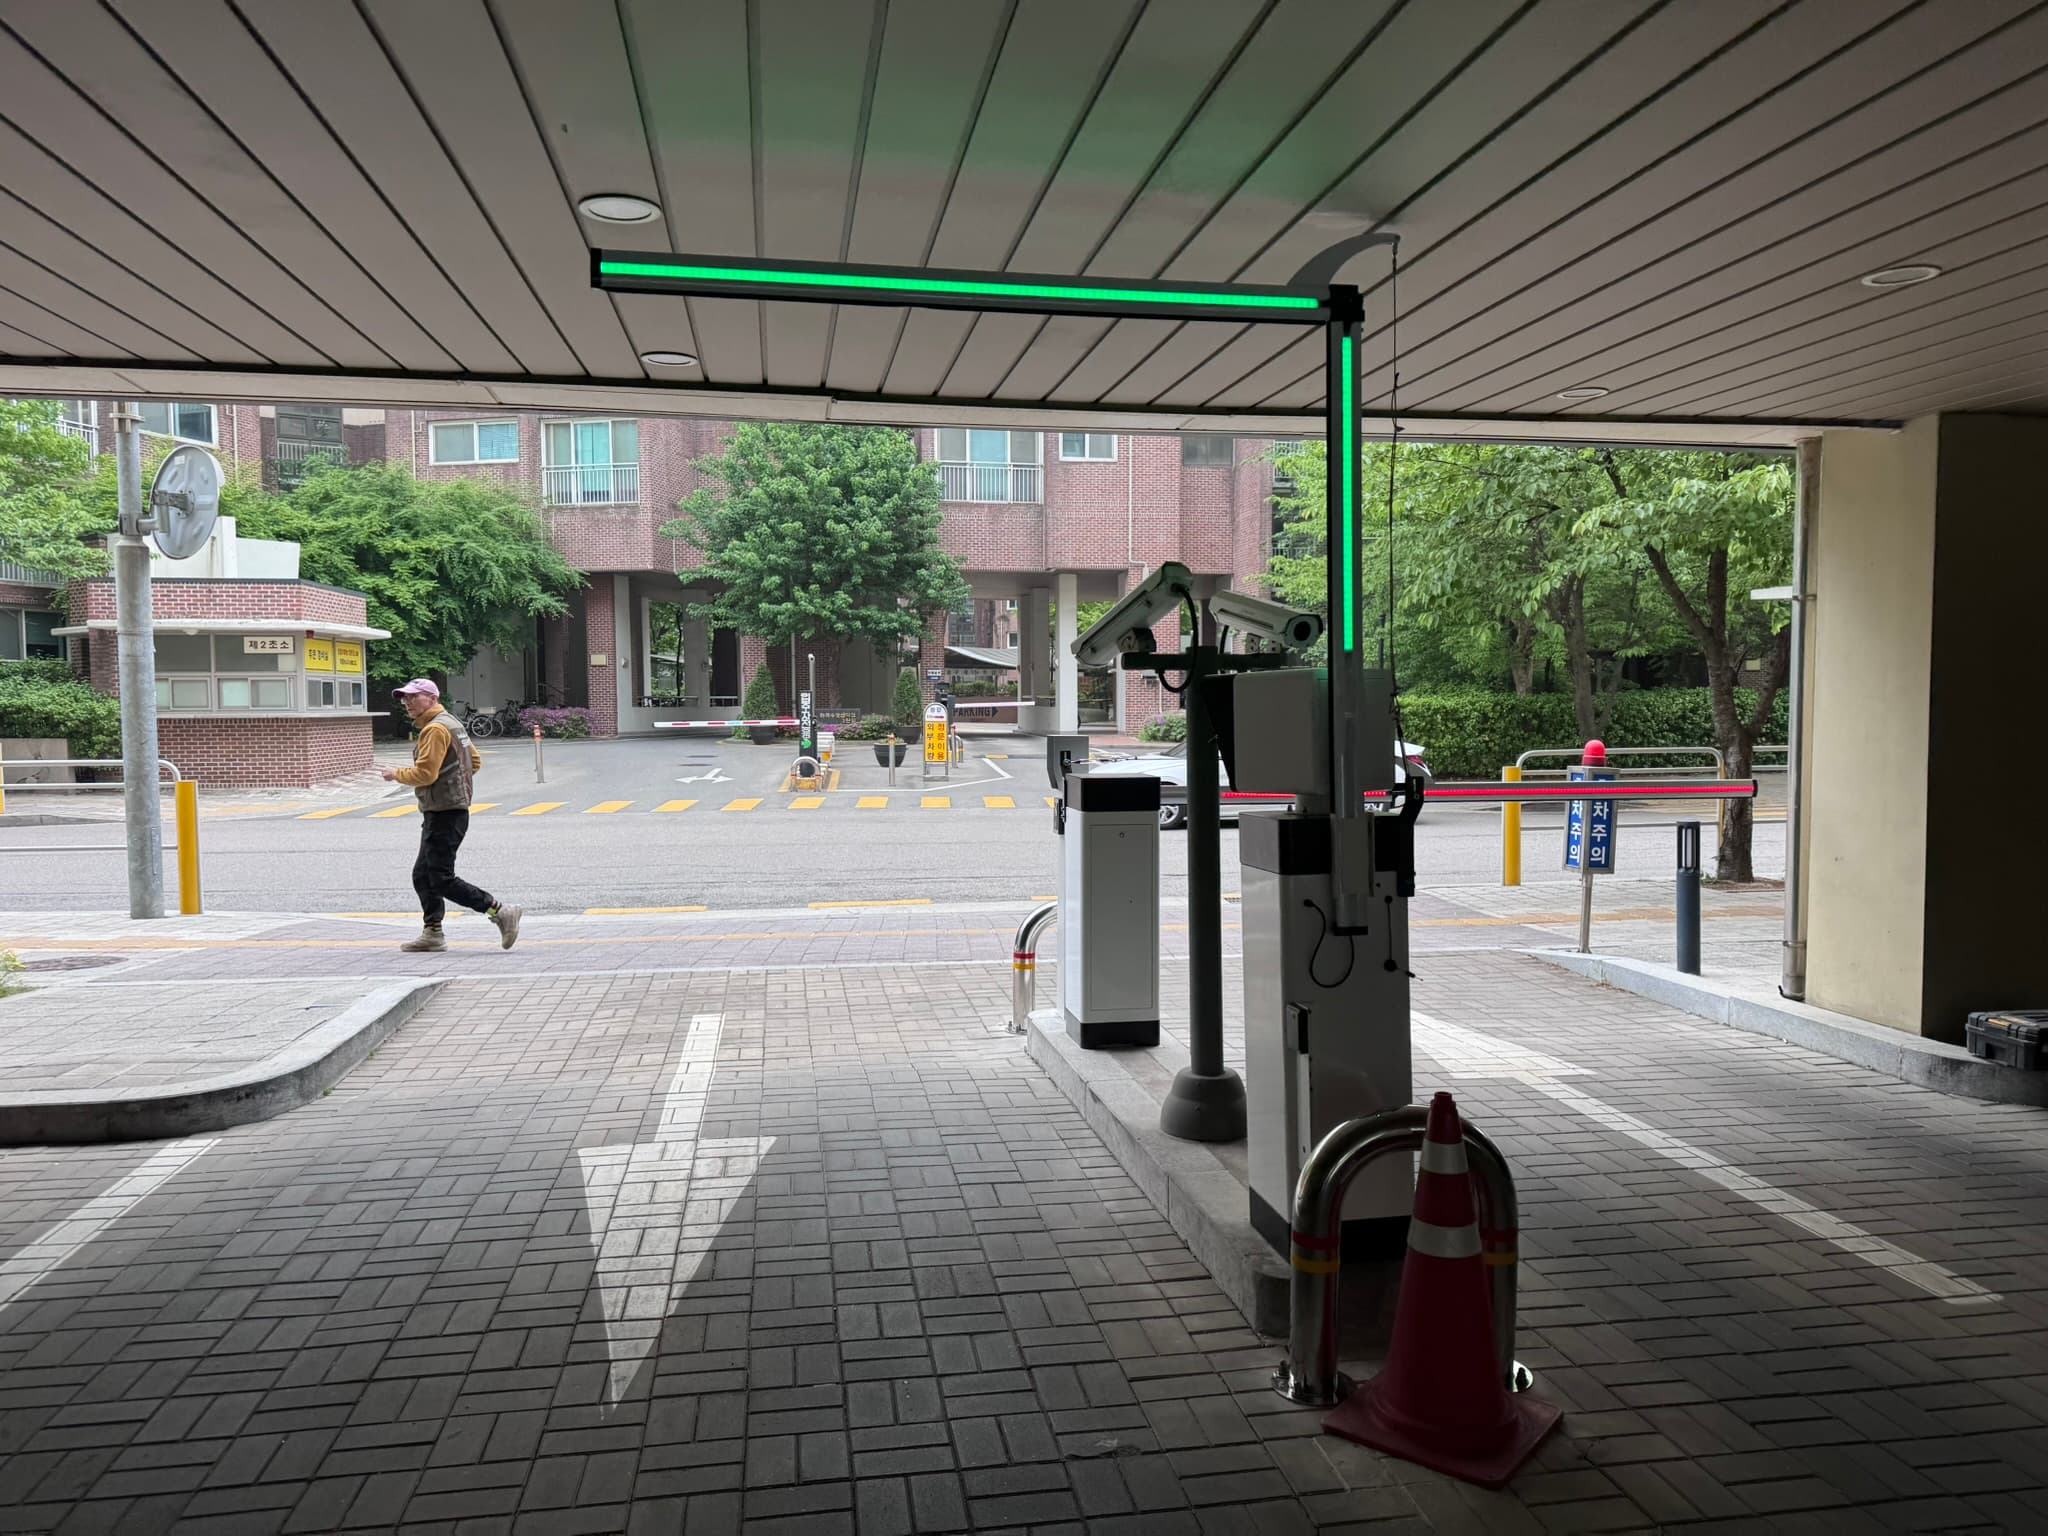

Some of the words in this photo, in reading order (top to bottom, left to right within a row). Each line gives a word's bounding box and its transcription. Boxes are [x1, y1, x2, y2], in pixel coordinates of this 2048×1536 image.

[248, 640, 290, 650] 제2초소
[1569, 777, 1583, 864] 차주의
[1590, 778, 1609, 865] 차주의
